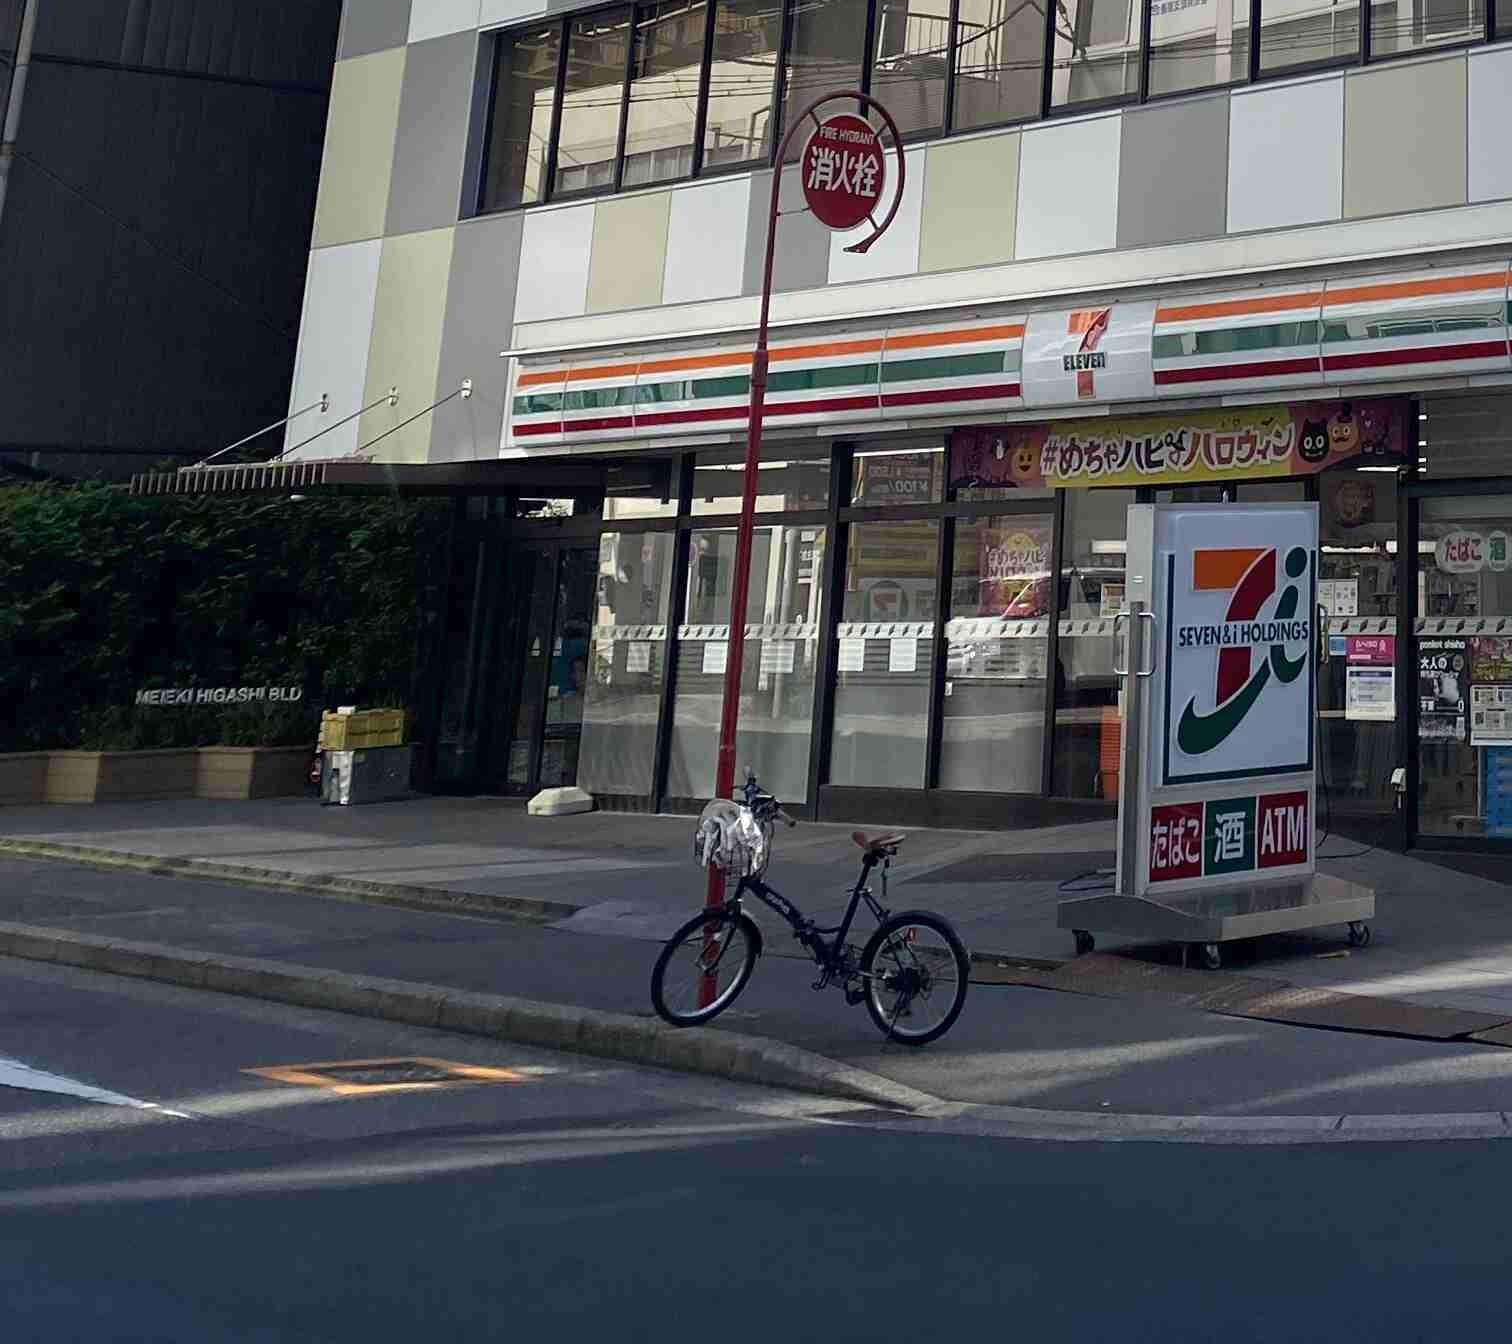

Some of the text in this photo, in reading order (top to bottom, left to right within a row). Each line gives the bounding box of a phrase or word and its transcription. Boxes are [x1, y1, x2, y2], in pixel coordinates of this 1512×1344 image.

[820, 126, 875, 145] FIRE HYDRANT
[807, 145, 879, 198] 消火栓
[1240, 620, 1309, 644] HOLDINGS
[135, 686, 302, 705] MEIEKI HIGASHI BLD
[1151, 804, 1305, 869] たばこ 酒 ATM
